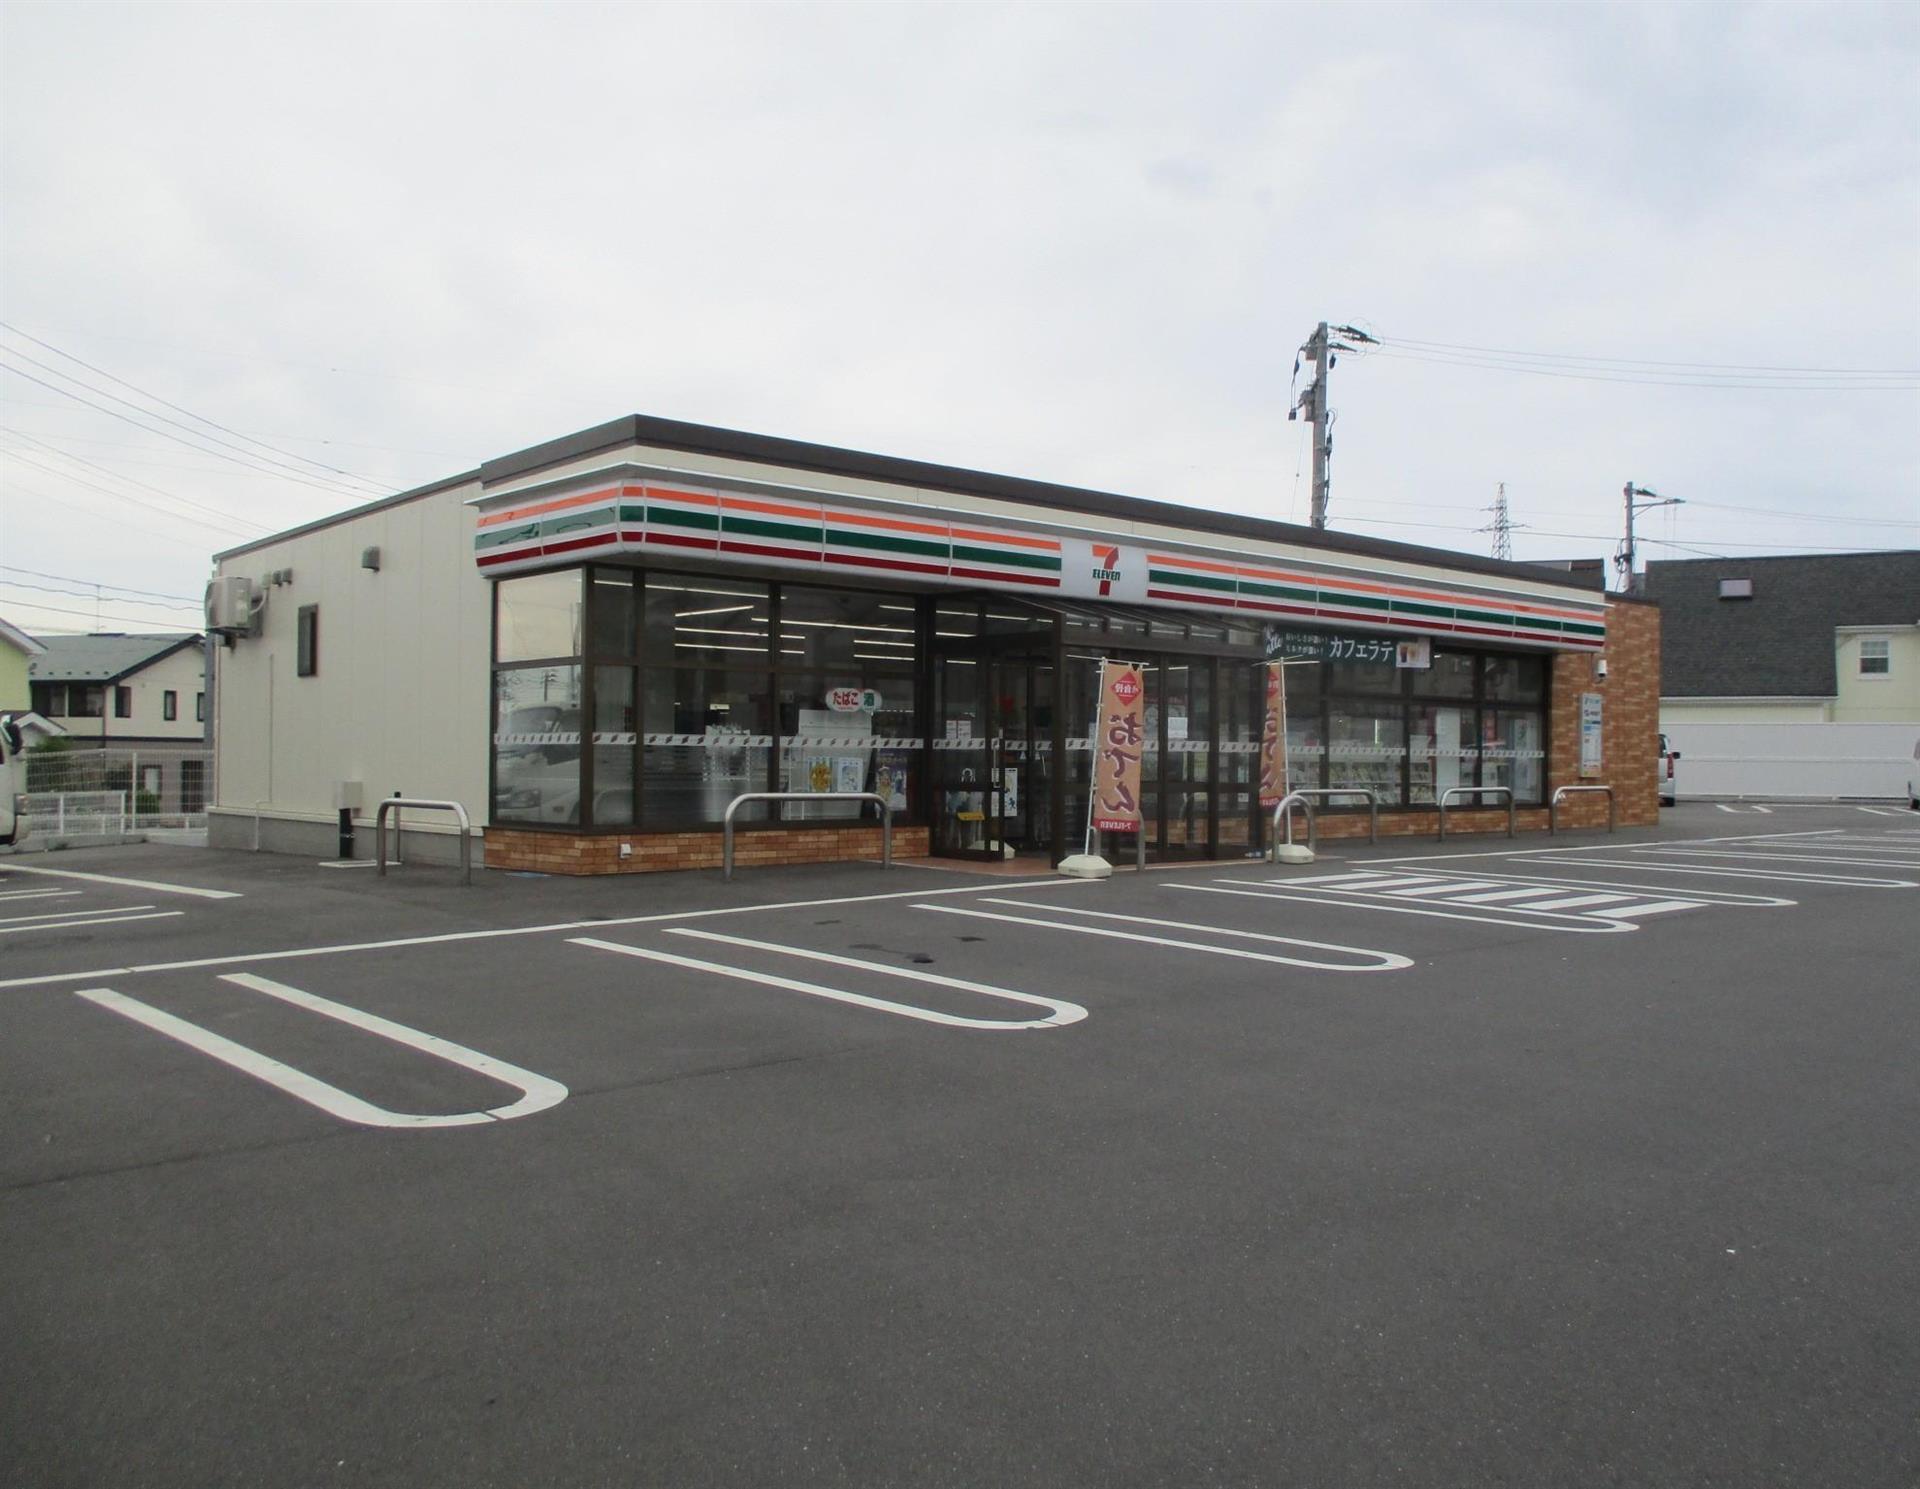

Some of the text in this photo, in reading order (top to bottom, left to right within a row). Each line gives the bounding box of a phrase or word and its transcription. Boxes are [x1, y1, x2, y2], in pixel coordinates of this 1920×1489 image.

[1092, 544, 1119, 596] 7
[1329, 635, 1394, 662] カフェラテ
[832, 690, 859, 706] たばこ
